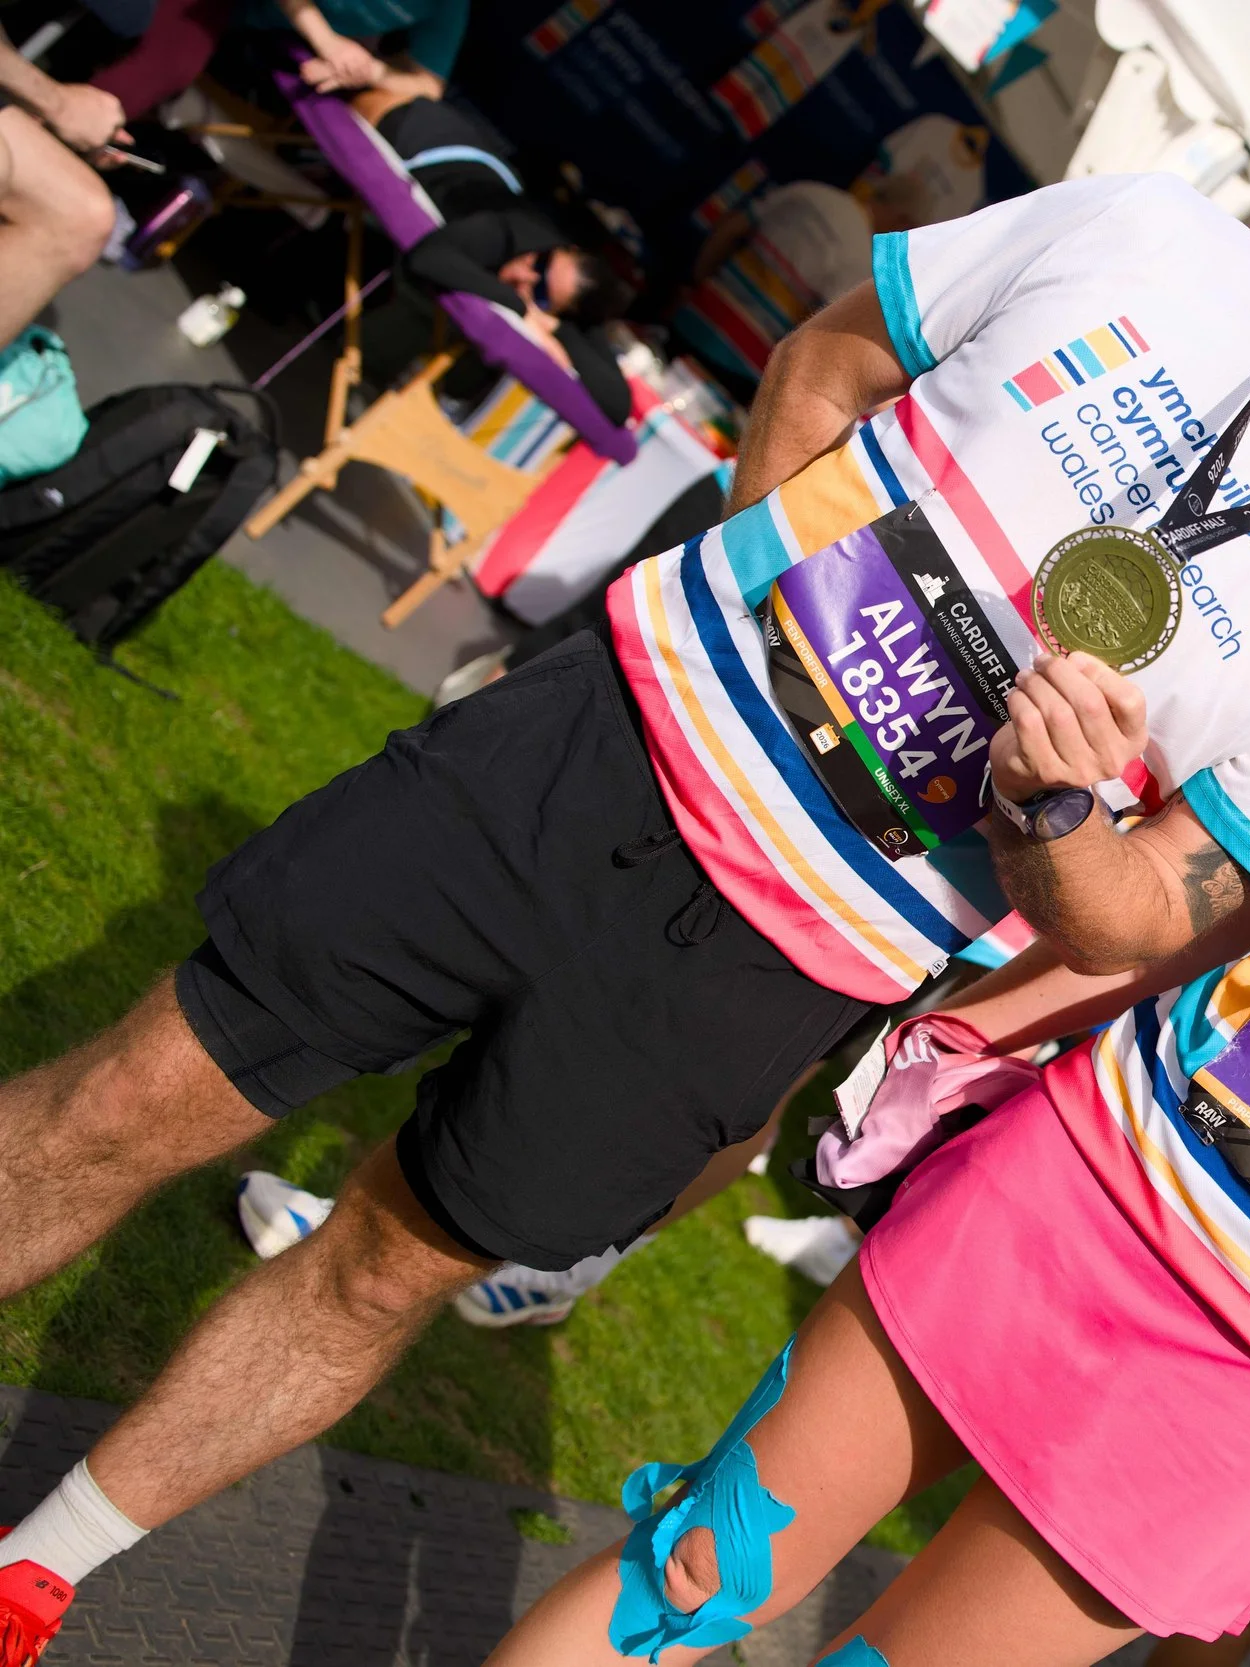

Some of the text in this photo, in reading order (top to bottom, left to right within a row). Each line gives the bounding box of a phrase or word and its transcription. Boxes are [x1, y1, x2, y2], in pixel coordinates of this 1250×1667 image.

[1040, 420, 1115, 525] wales
[1076, 403, 1162, 518] cancer
[1206, 452, 1226, 486] 2026
[1201, 514, 1226, 531] HALF
[783, 619, 829, 688] PEN PORFFOR
[936, 611, 963, 646] HANNER
[958, 645, 992, 693] MARATHON
[951, 602, 1006, 680] CARDIFF
[827, 630, 938, 780] 18354
[860, 599, 988, 763] ALWYN
[815, 730, 830, 749] 2026
[874, 766, 911, 816] UNISEX XL
[1194, 1100, 1226, 1128] R4W
[50, 1585, 67, 1602] 1080
